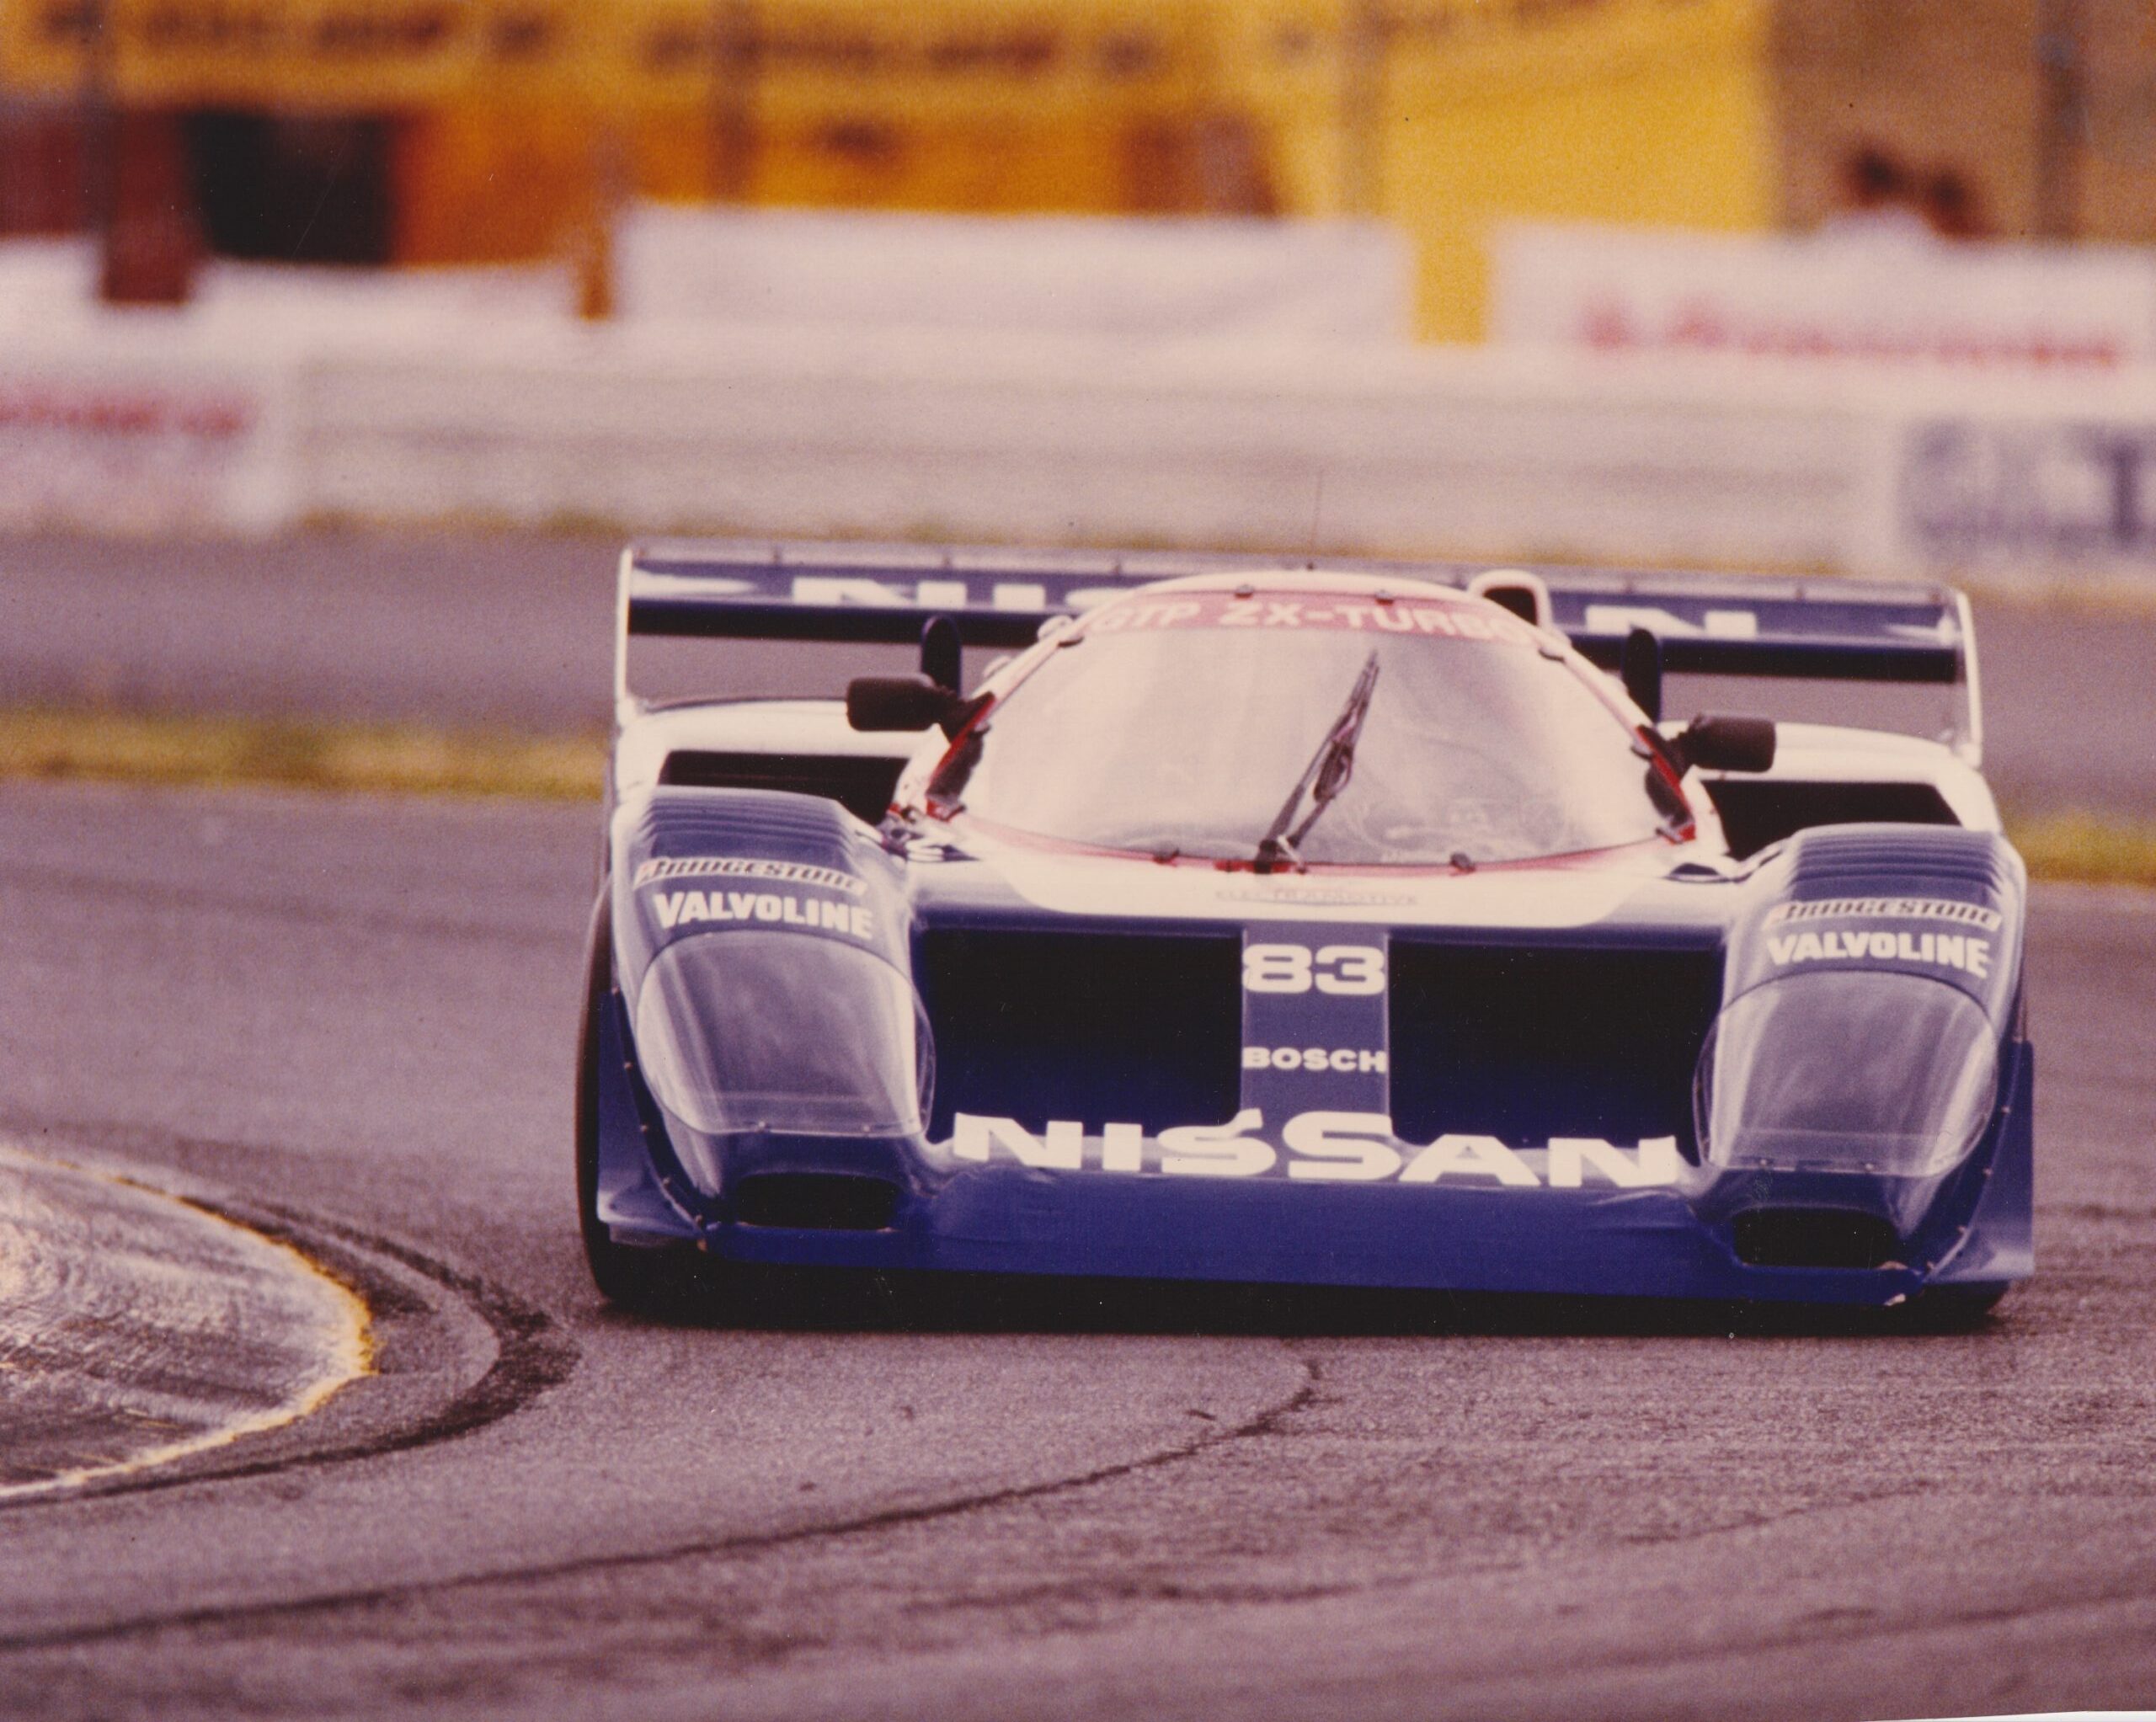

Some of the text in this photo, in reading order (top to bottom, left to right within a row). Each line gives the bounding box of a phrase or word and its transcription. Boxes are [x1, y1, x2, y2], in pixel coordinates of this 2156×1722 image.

[1092, 602, 1199, 631] GTP
[654, 891, 873, 940] VALVOLINE
[1242, 944, 1385, 995] 83
[1769, 931, 1992, 978] VALVOLINE
[1242, 1048, 1386, 1074] BOSCH
[953, 1109, 1678, 1186] NISSAN
